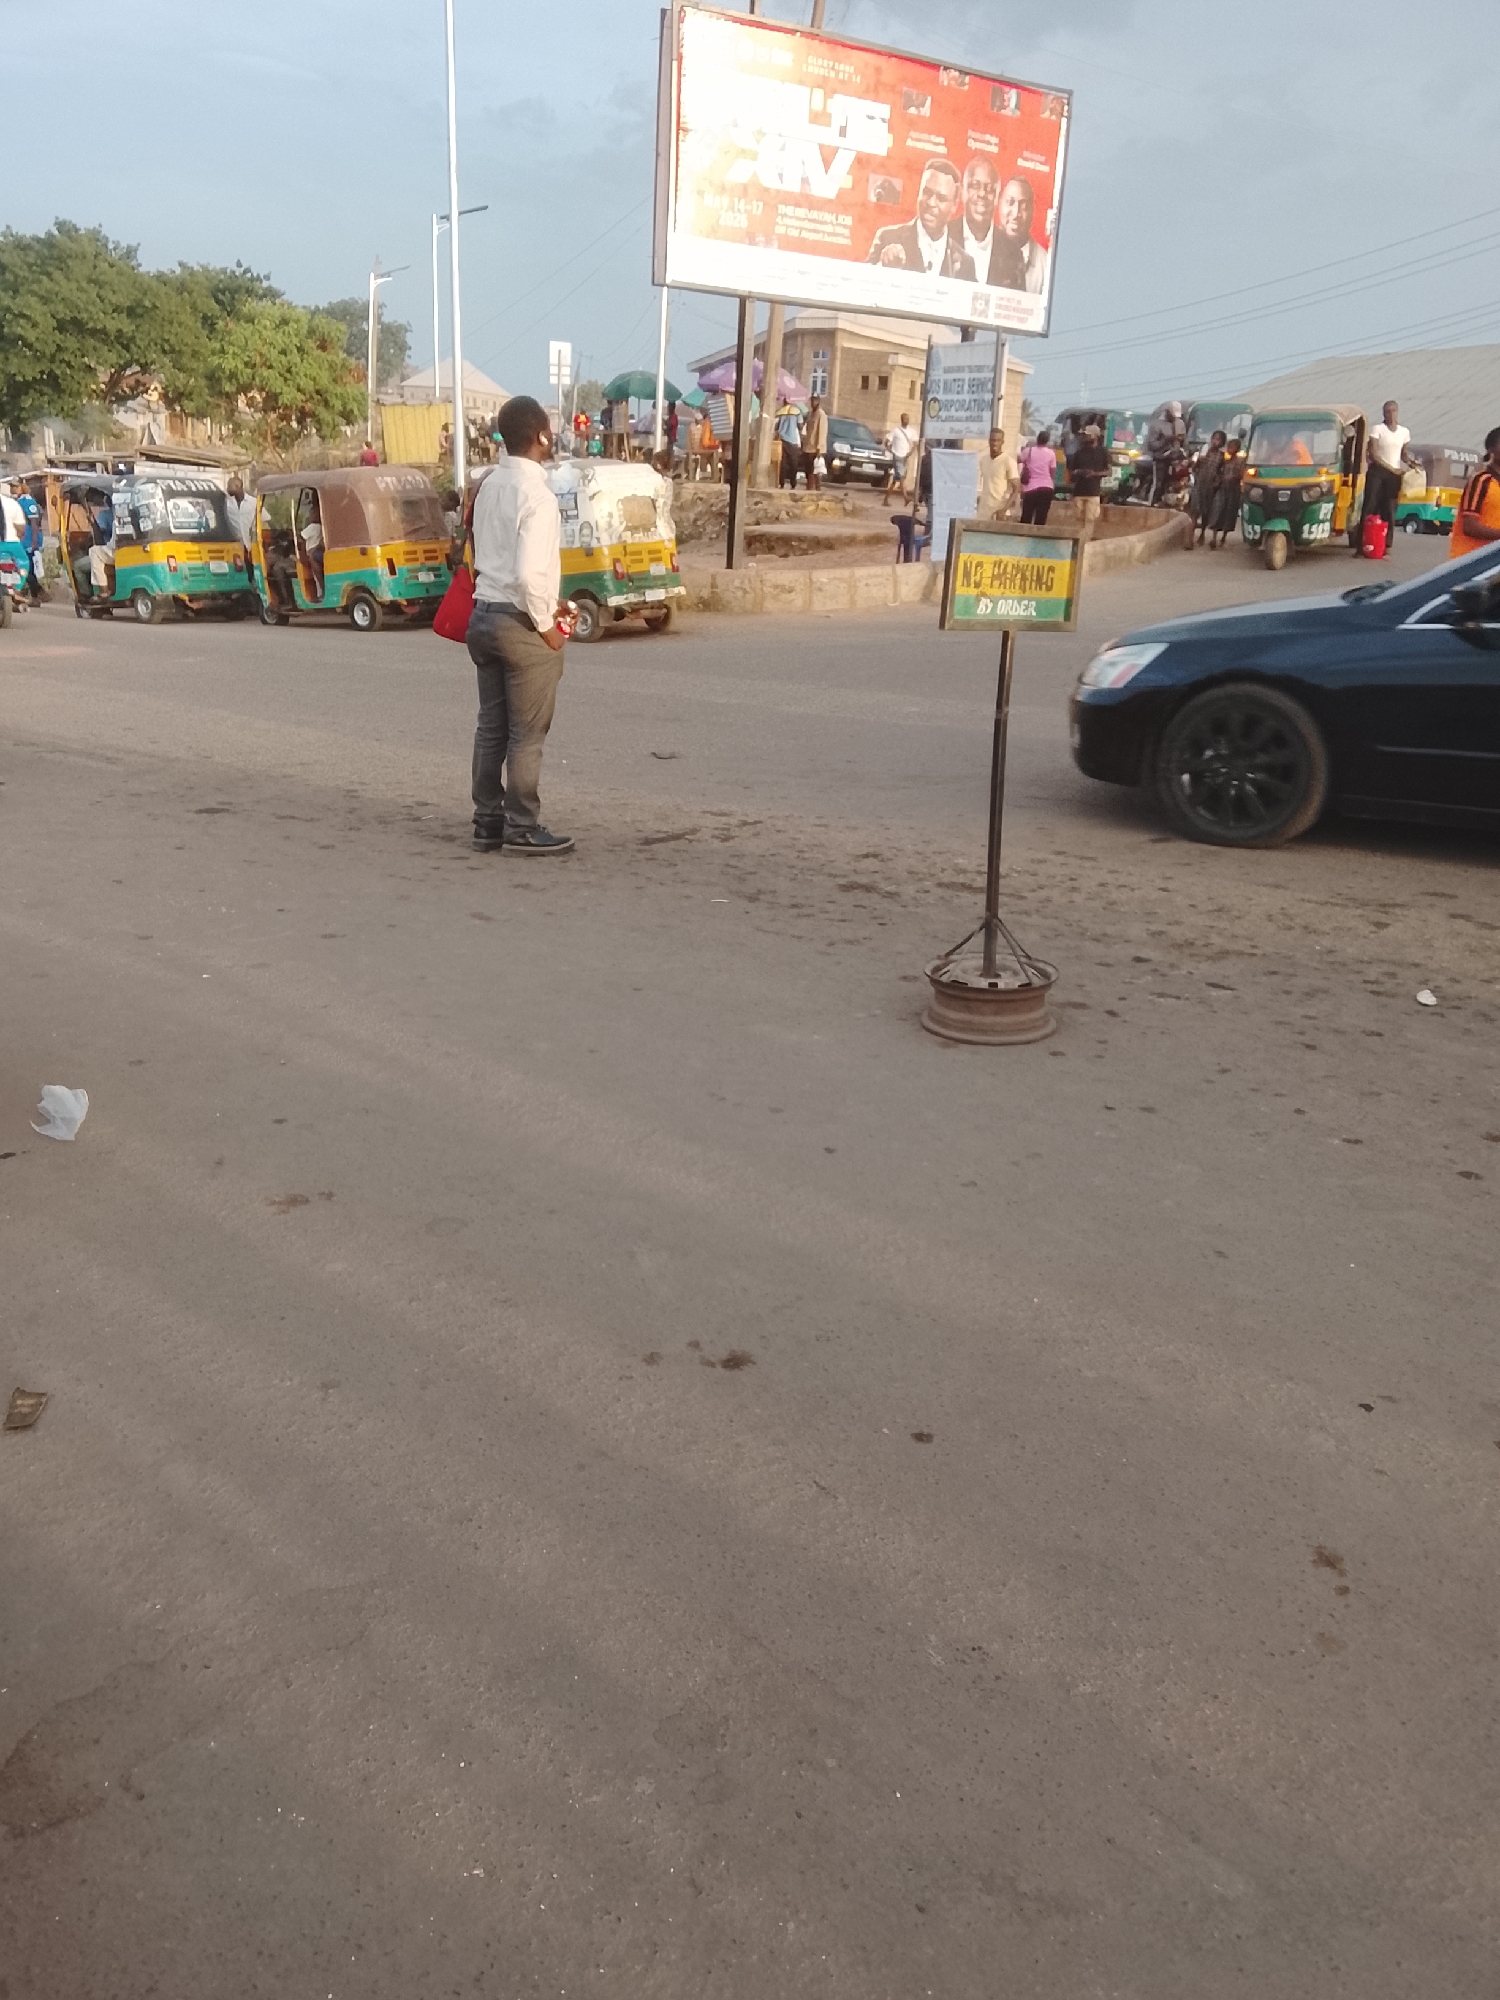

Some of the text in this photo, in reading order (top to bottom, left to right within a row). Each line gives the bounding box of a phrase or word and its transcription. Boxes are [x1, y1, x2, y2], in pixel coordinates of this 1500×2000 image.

[718, 209, 749, 229] 2026
[942, 378, 966, 395] WATER
[961, 558, 1056, 594] NO PARKING
[976, 596, 1037, 617] BY ORDER
